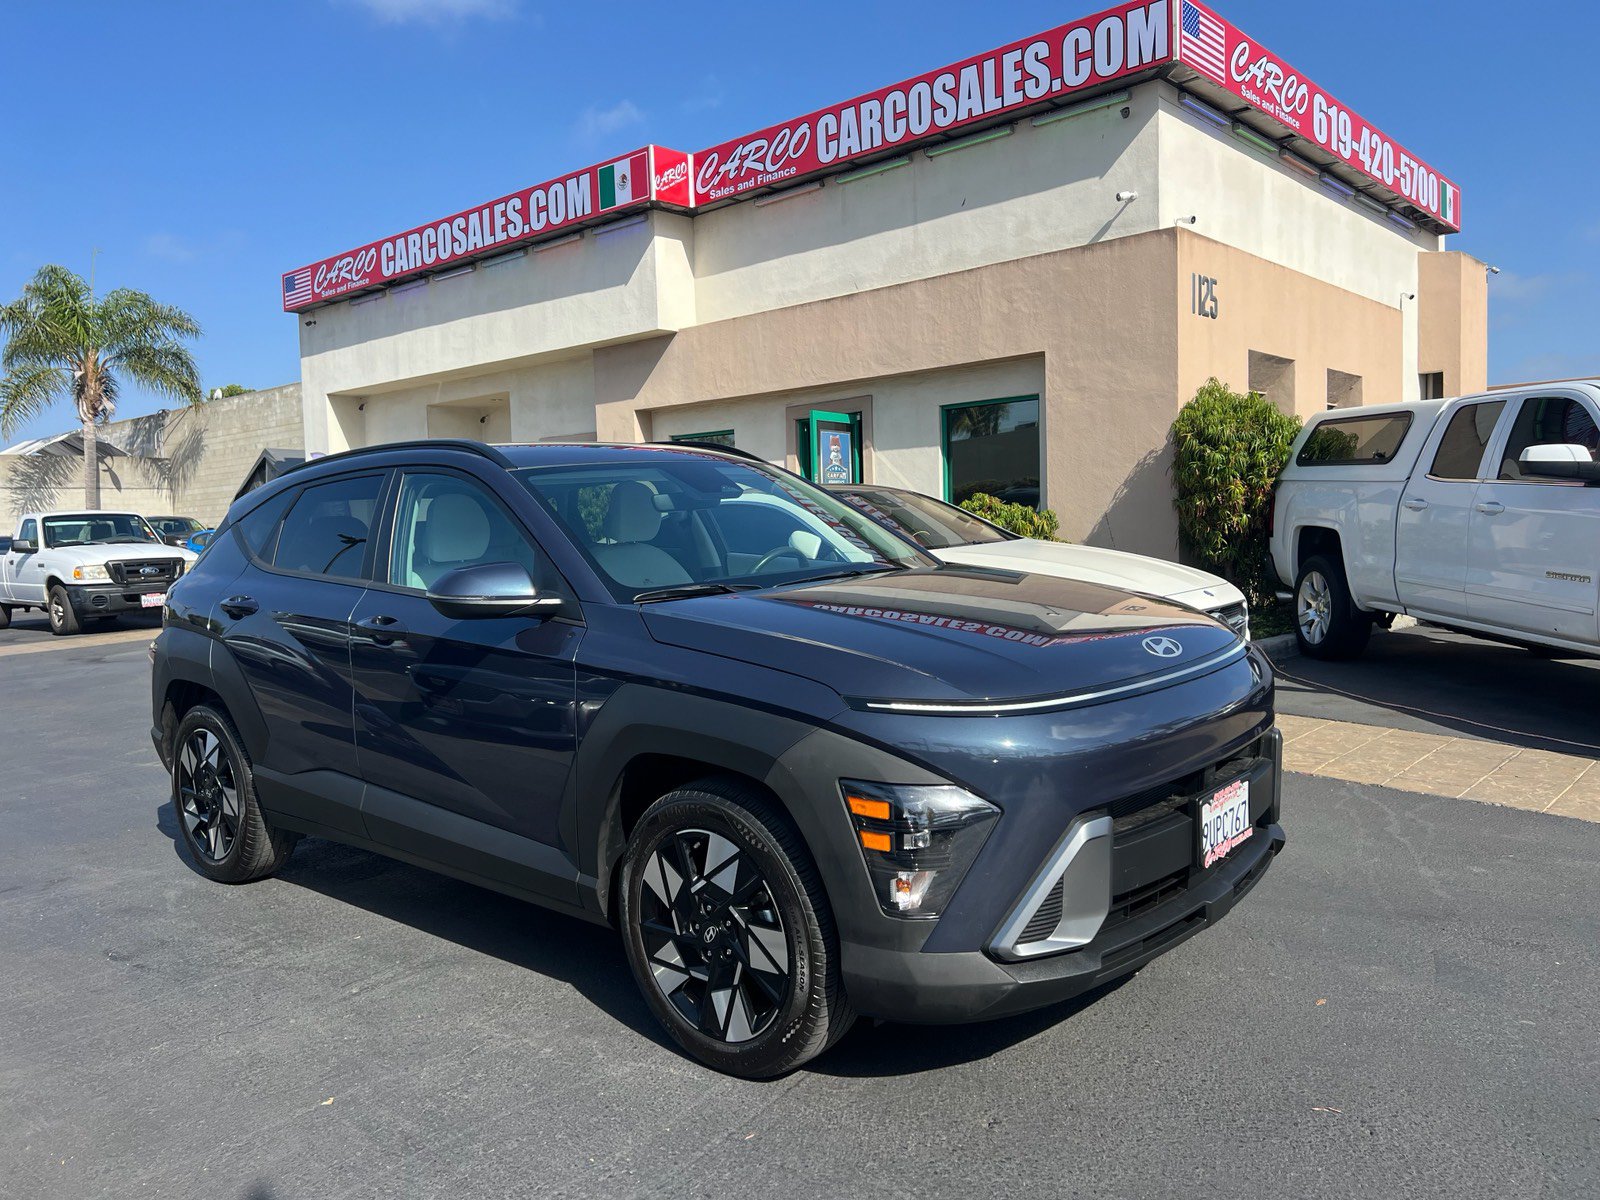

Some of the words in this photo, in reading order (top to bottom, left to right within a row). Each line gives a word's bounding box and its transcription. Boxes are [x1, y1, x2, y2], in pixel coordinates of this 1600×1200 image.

[816, 0, 1169, 165] CARCOSALES.COM
[1231, 41, 1308, 115] CARCO
[1241, 84, 1261, 105] Sales
[1262, 100, 1275, 114] and
[1275, 105, 1300, 129] Finance
[655, 161, 688, 191] CARCO
[695, 122, 811, 194] CARCO
[1313, 93, 1438, 213] 619-420-5700
[709, 185, 735, 200] Sales
[737, 179, 755, 191] and
[757, 166, 797, 185] Finance
[314, 247, 377, 294] CARCO
[381, 172, 592, 277] CARCOSALES.COM
[321, 287, 336, 297] Sales
[336, 284, 347, 293] and
[347, 278, 370, 290] Finance
[1192, 272, 1218, 320] 1125
[1202, 800, 1247, 851] 9UPC767
